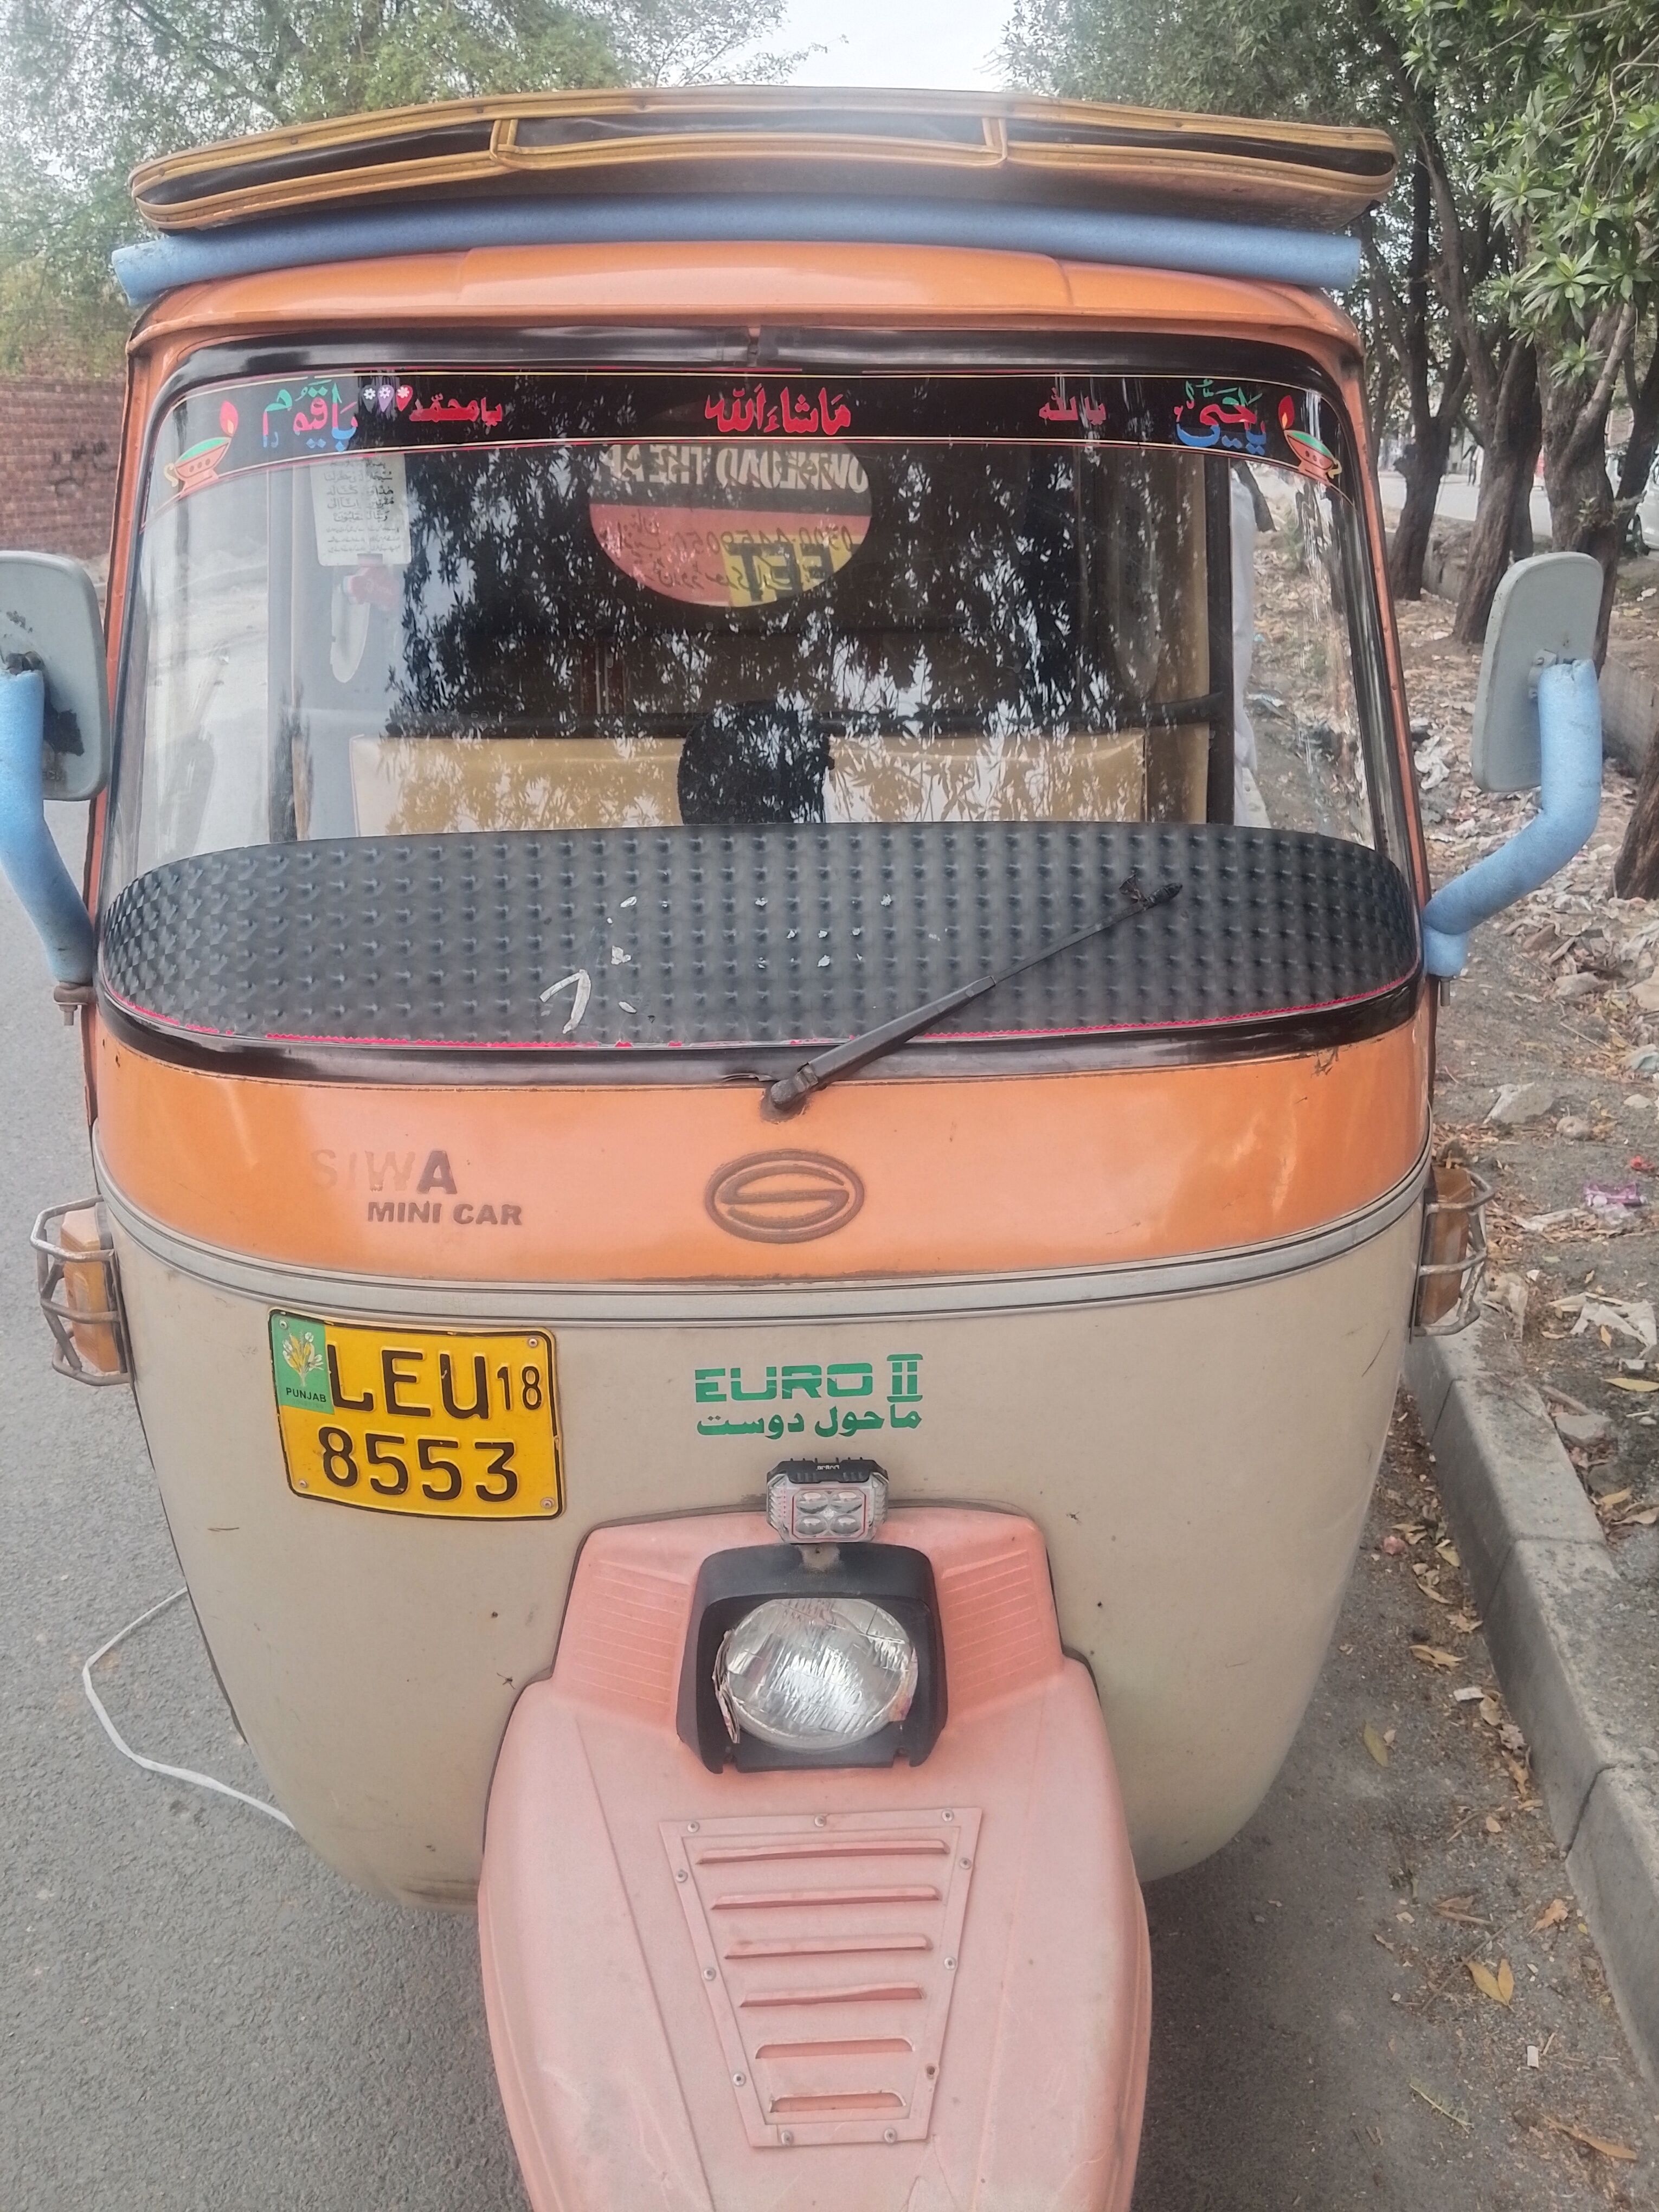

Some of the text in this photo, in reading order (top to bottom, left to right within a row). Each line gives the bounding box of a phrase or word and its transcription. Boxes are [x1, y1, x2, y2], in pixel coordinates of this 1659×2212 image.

[367, 1200, 523, 1226] MINI CAR
[286, 1387, 326, 1403] PUNJAB
[326, 1343, 543, 1420] LEU 18
[695, 1353, 924, 1403] EURO II
[697, 1404, 923, 1440] ماحول دوست
[318, 1426, 518, 1503] 8553
